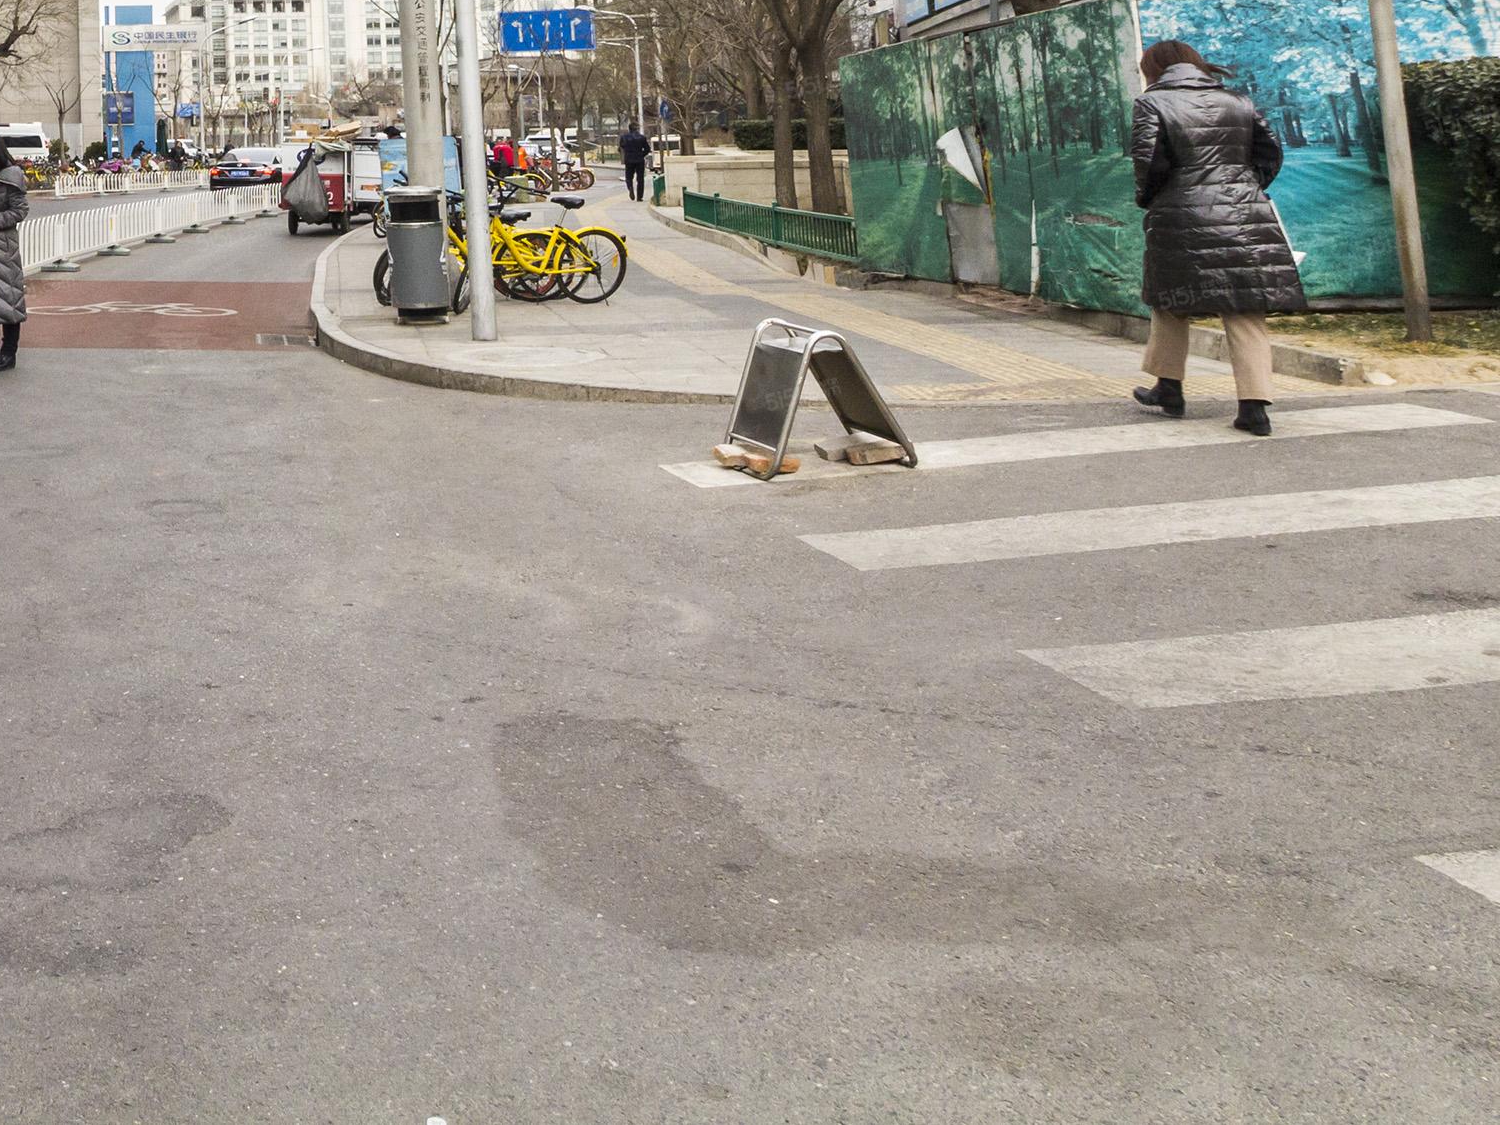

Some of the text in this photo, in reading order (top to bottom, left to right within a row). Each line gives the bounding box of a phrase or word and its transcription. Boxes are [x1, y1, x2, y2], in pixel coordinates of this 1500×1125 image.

[133, 30, 198, 40] 中国民生银行
